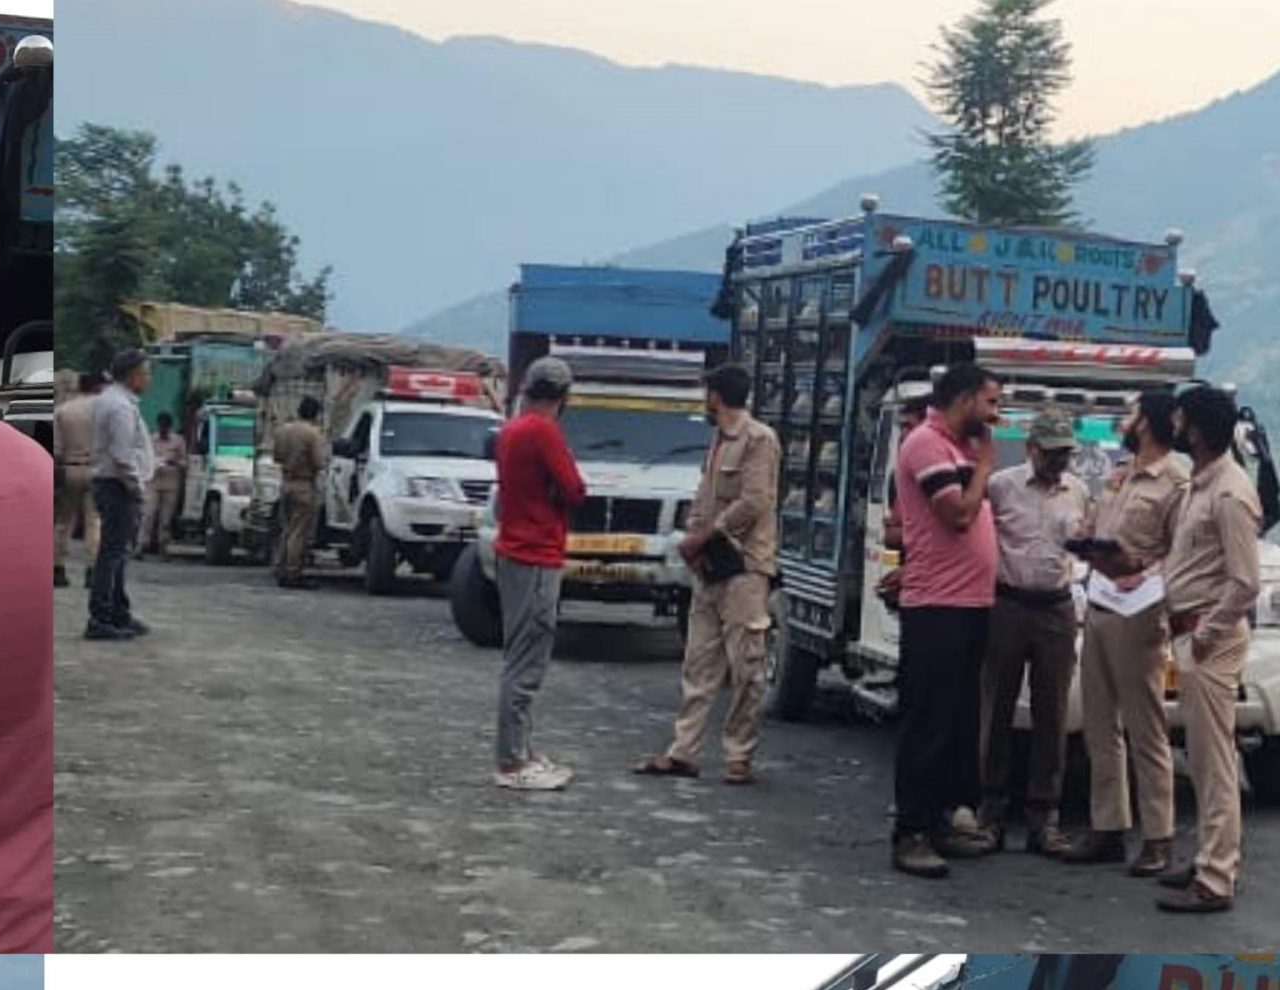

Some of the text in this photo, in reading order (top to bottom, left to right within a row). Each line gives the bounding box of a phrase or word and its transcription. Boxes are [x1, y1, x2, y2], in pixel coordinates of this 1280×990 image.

[919, 230, 962, 251] ALL
[925, 263, 1169, 321] BUTT POULTRY
